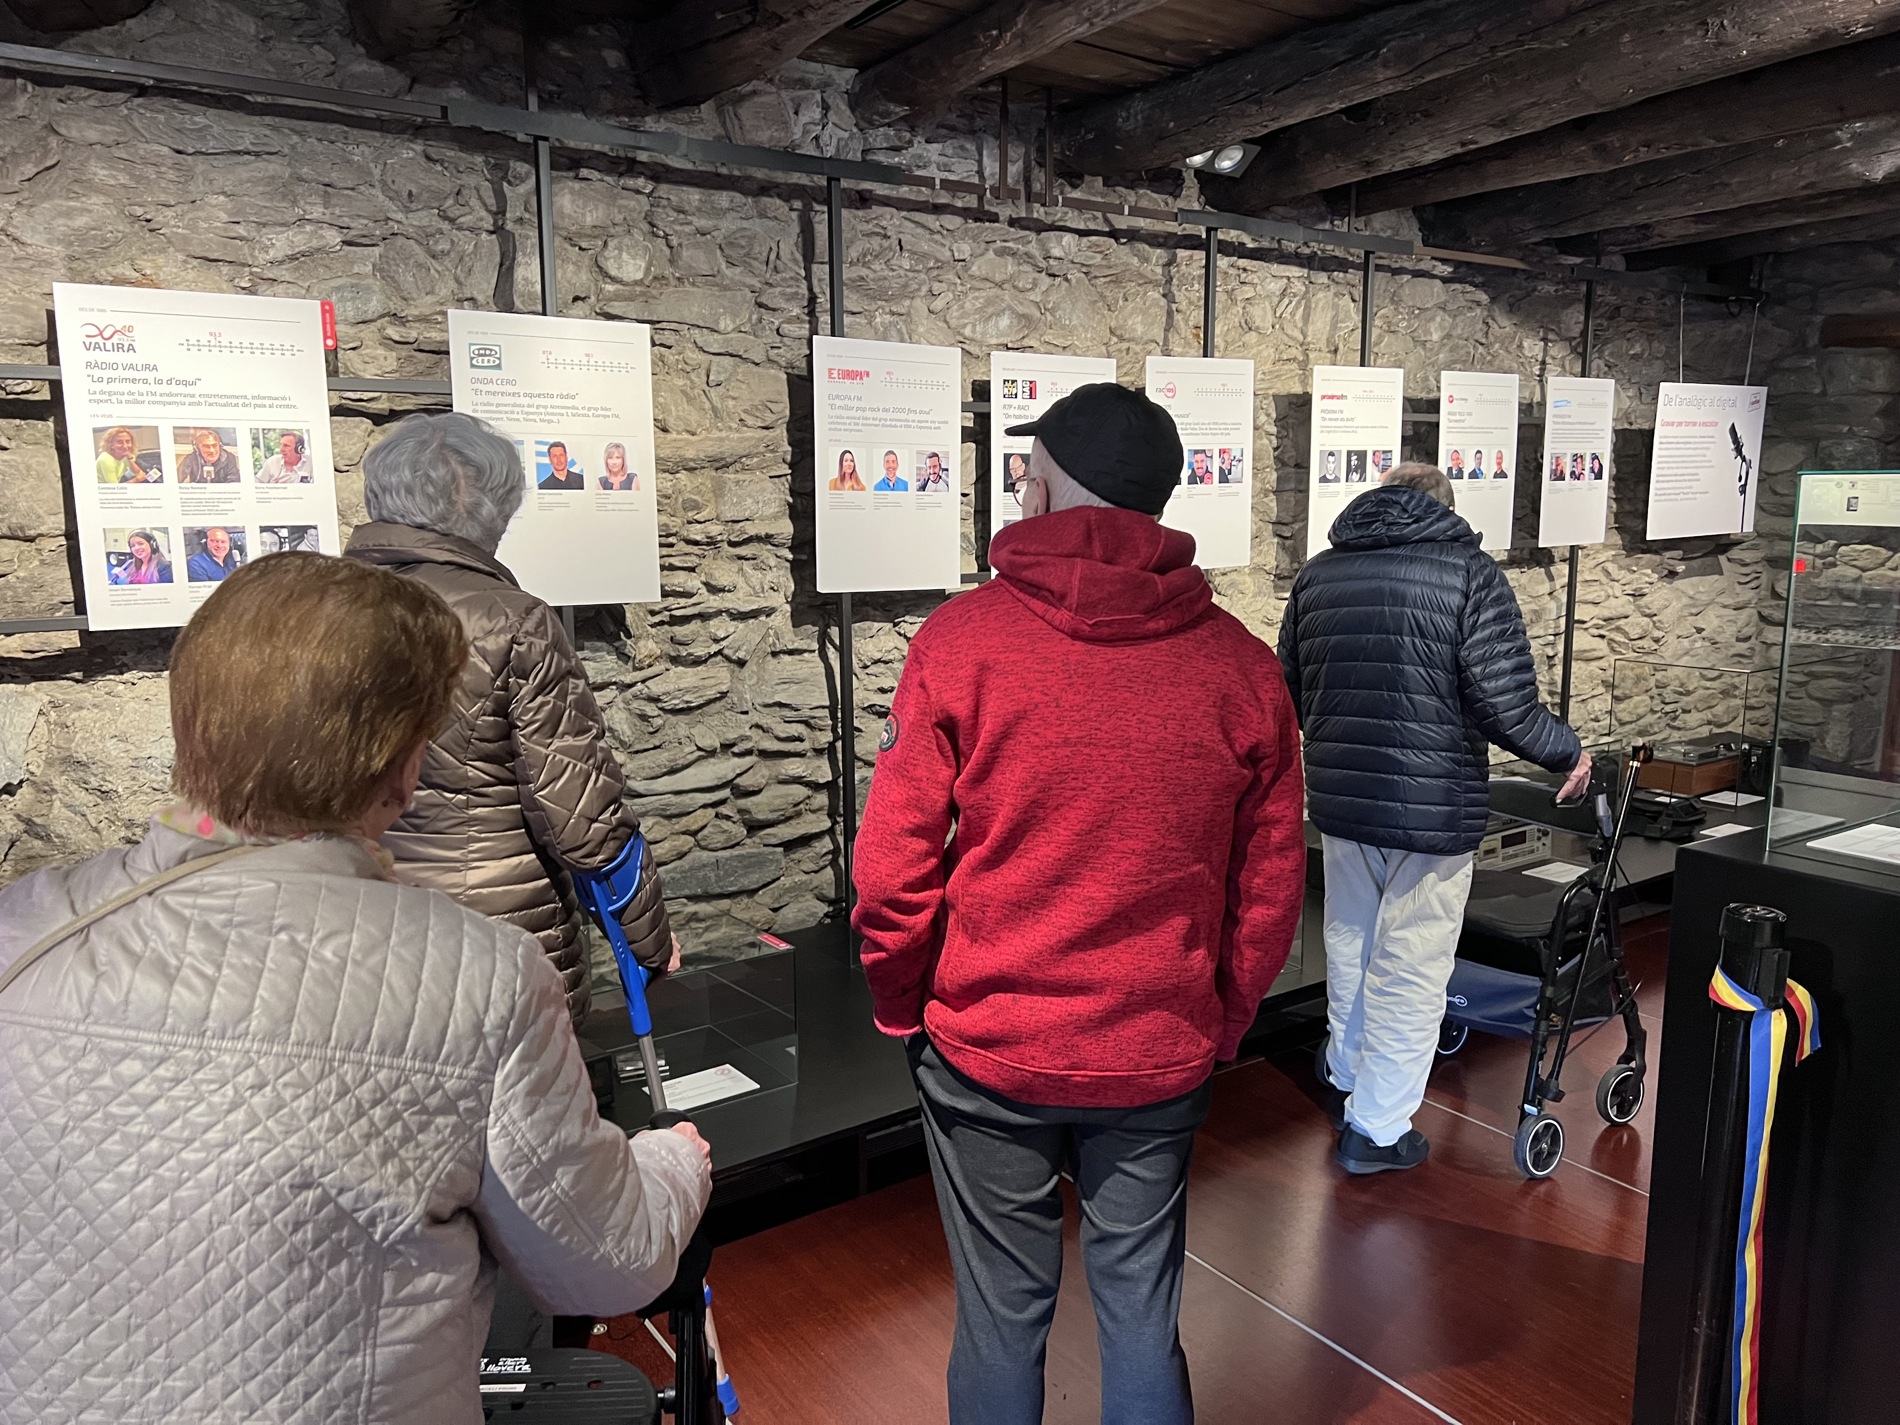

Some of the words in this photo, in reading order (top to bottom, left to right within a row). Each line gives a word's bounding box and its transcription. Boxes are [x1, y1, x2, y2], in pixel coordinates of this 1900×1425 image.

[82, 341, 136, 353] VALIRA
[85, 359, 119, 371] RÀDIO
[121, 362, 159, 372] VALIRA
[837, 368, 863, 381] EUROPA
[106, 375, 151, 386] primera,
[154, 377, 163, 385] la
[470, 377, 494, 386] ONDA
[495, 378, 517, 387] CERO
[99, 389, 125, 397] degana
[199, 393, 250, 401] entreteniment,
[484, 390, 521, 398] mereixes
[522, 391, 555, 399] aquesta
[828, 393, 852, 401] EUROPA
[852, 394, 863, 402] FM
[1663, 393, 1673, 407] De
[1708, 396, 1715, 408] al
[1716, 396, 1737, 410] digital
[891, 406, 907, 414] 2000
